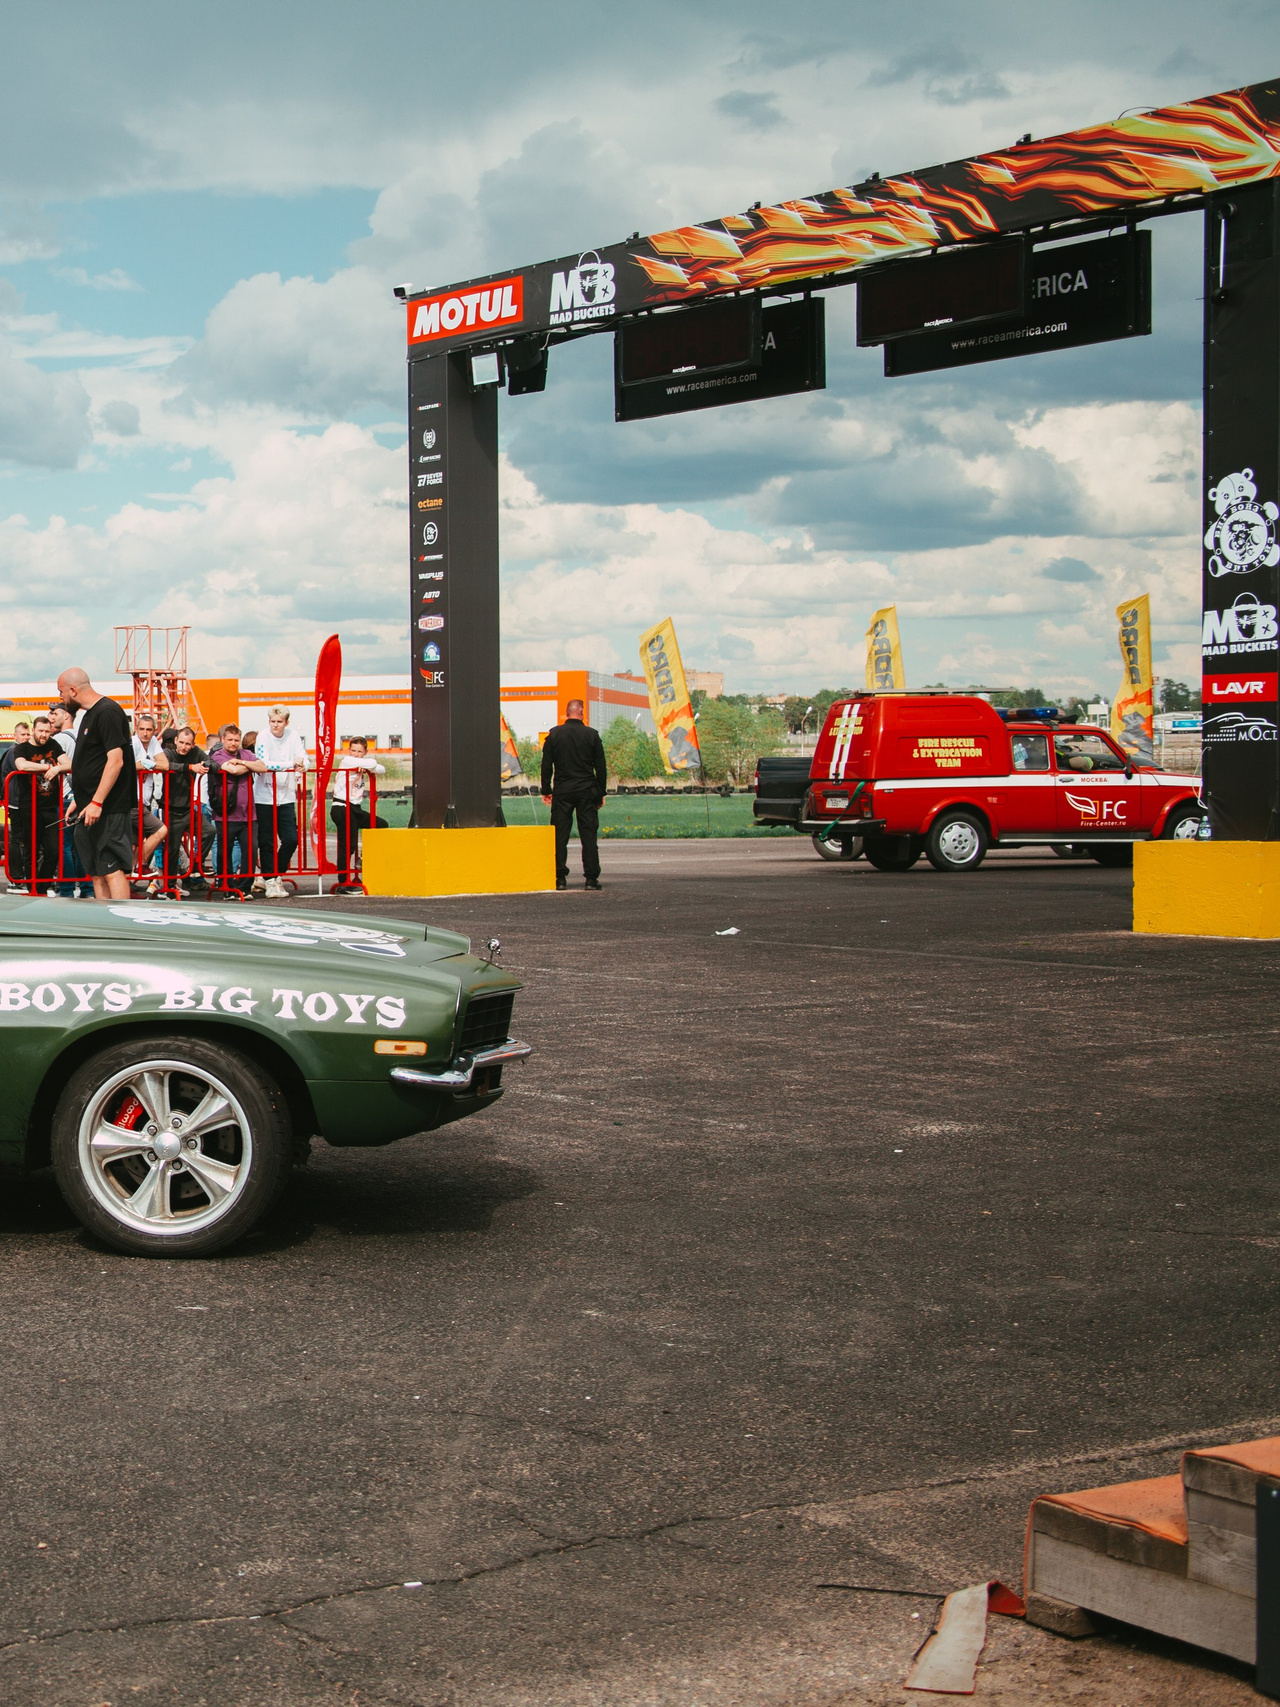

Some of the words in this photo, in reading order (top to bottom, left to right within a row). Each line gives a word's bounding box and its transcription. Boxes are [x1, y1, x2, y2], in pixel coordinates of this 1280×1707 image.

[1032, 268, 1089, 299] RICA
[412, 285, 518, 338] MOTUL
[549, 311, 573, 325] MAD
[573, 303, 616, 321] BUCKETS
[951, 320, 1068, 350] www.raceamerica.com
[666, 372, 757, 395] www.raceamerica.com
[426, 478, 443, 486] FORCE
[417, 498, 443, 509] octane
[1202, 646, 1228, 656] MAD
[1229, 640, 1278, 654] BUCKETS
[433, 671, 445, 684] FC
[1212, 681, 1265, 695] LAVR
[918, 739, 939, 748] FIRE
[940, 738, 975, 747] RESCUE
[912, 749, 919, 758] &
[920, 748, 982, 758] EXTRICATION
[935, 758, 961, 767] TEAM
[1102, 800, 1127, 819] FC
[158, 984, 259, 1015] BIG
[271, 988, 407, 1029] TOYS
